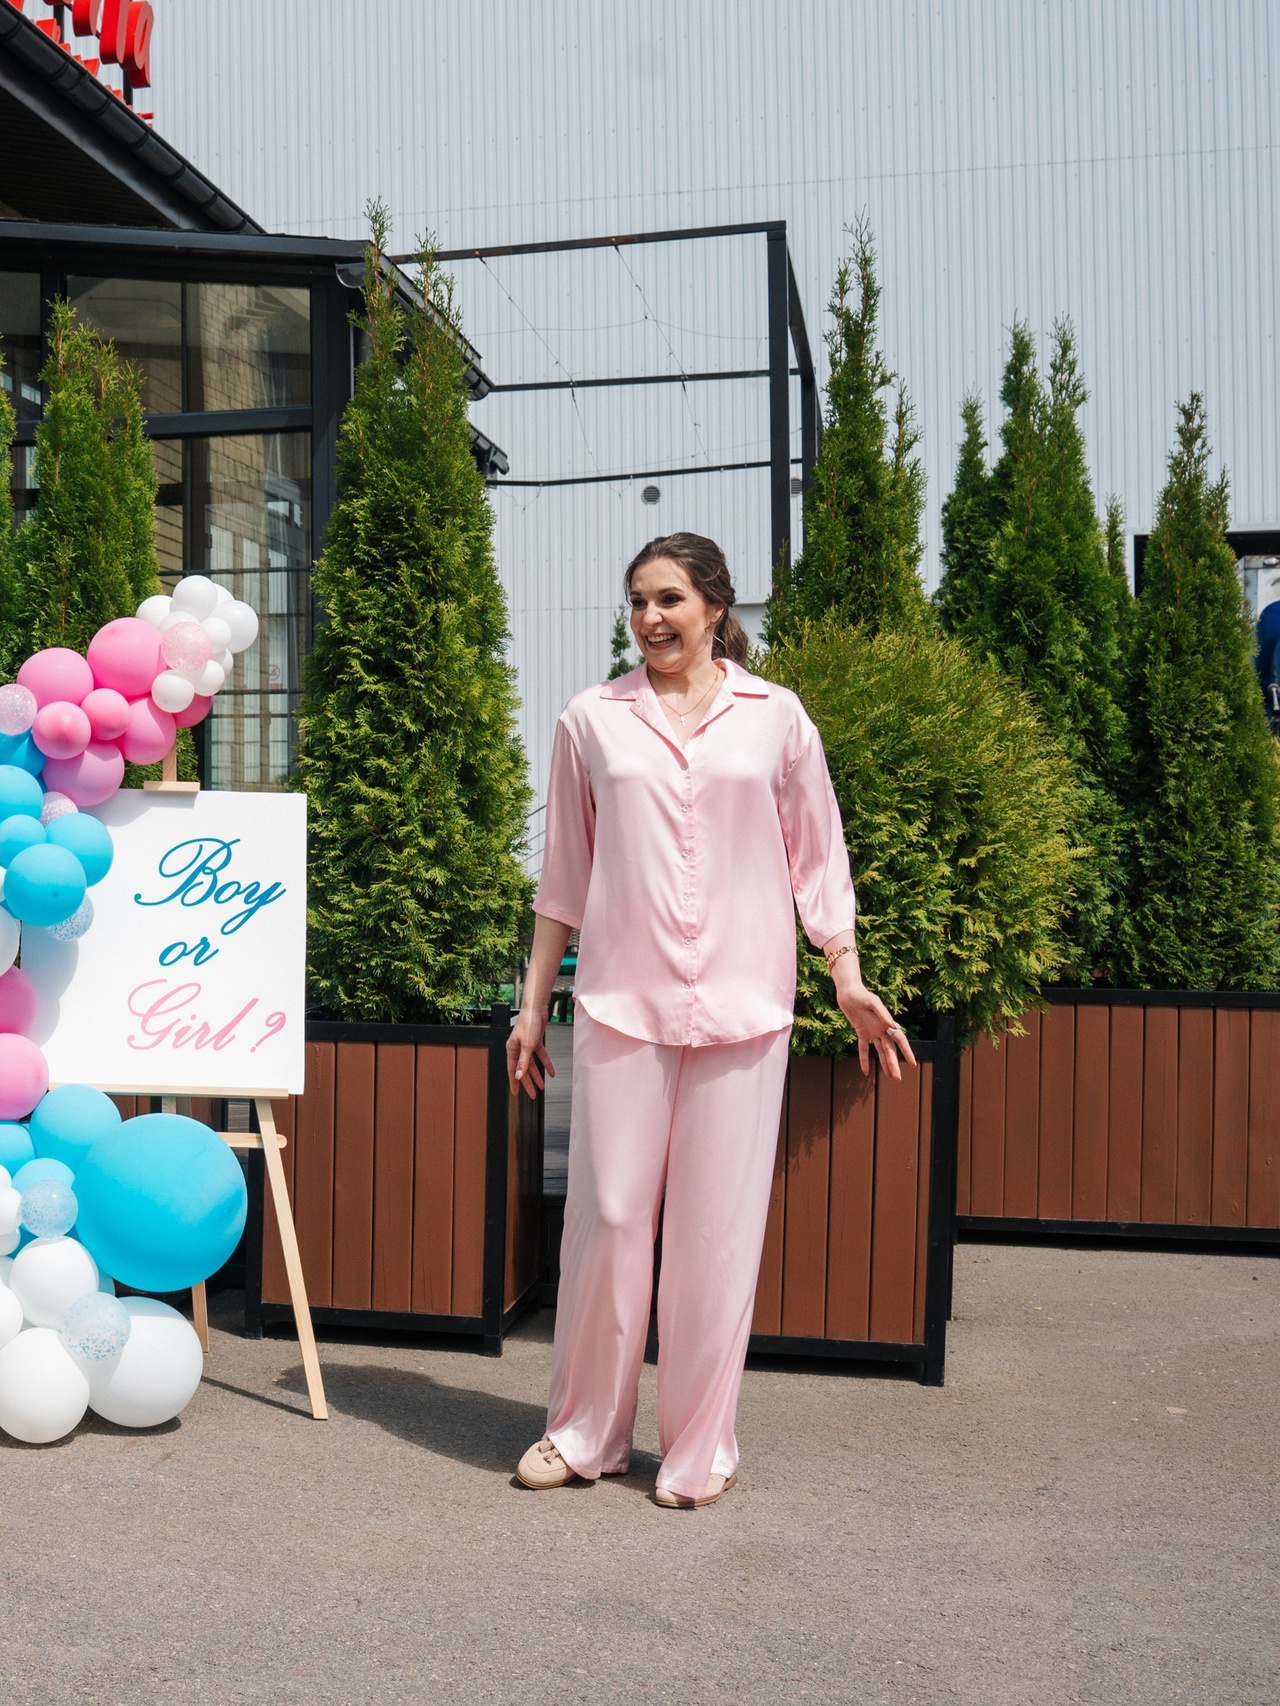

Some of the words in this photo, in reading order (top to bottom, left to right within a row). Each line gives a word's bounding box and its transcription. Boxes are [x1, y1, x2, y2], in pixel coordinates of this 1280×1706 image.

[133, 837, 287, 936] Boy
[158, 936, 220, 967] or
[126, 978, 260, 1051] Girl
